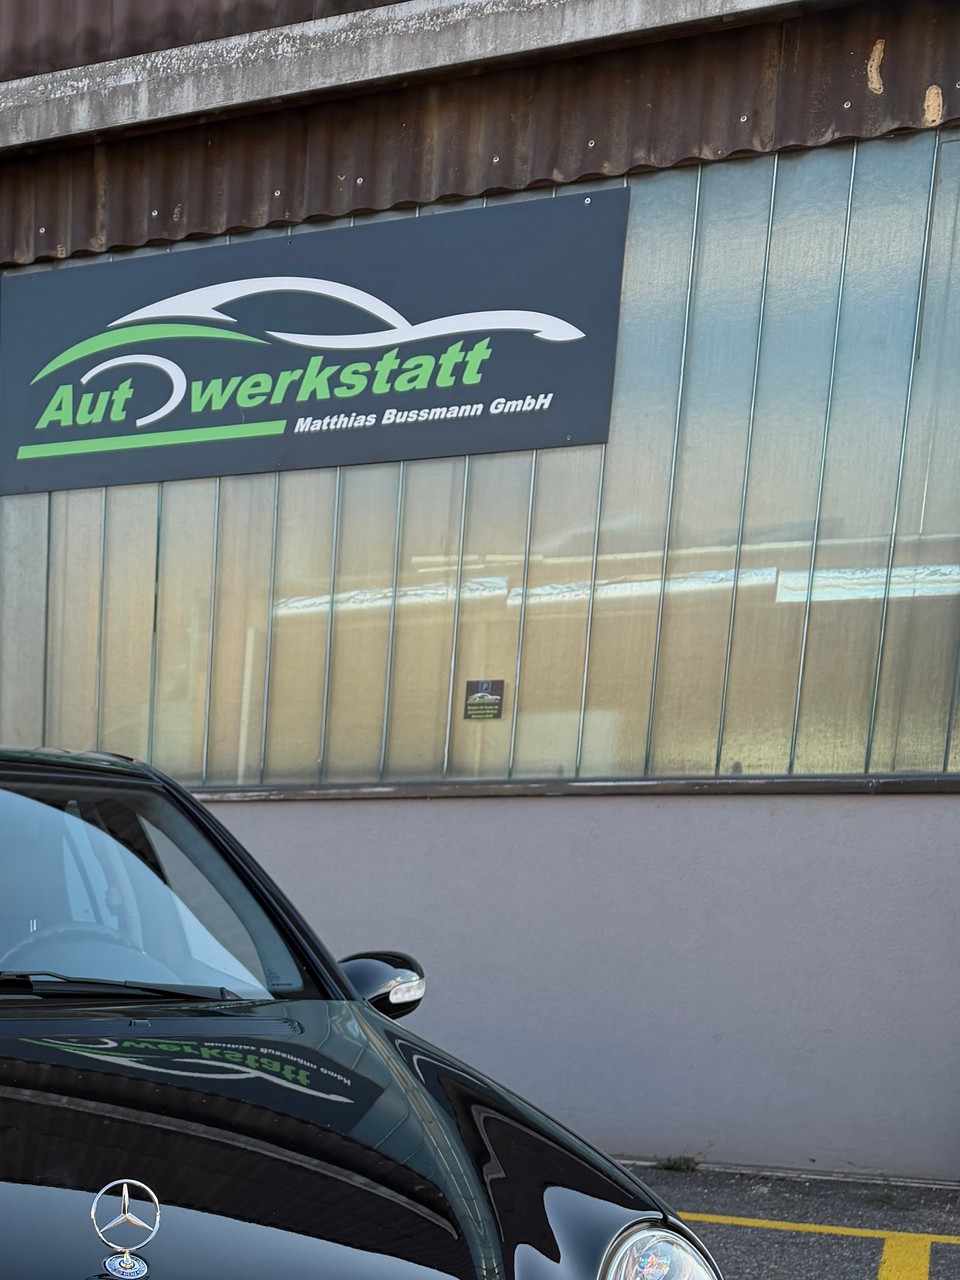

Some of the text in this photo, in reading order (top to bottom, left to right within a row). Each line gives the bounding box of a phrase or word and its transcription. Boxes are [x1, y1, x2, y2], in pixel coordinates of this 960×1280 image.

[293, 392, 554, 434] Matthias Bussmann GmbH
